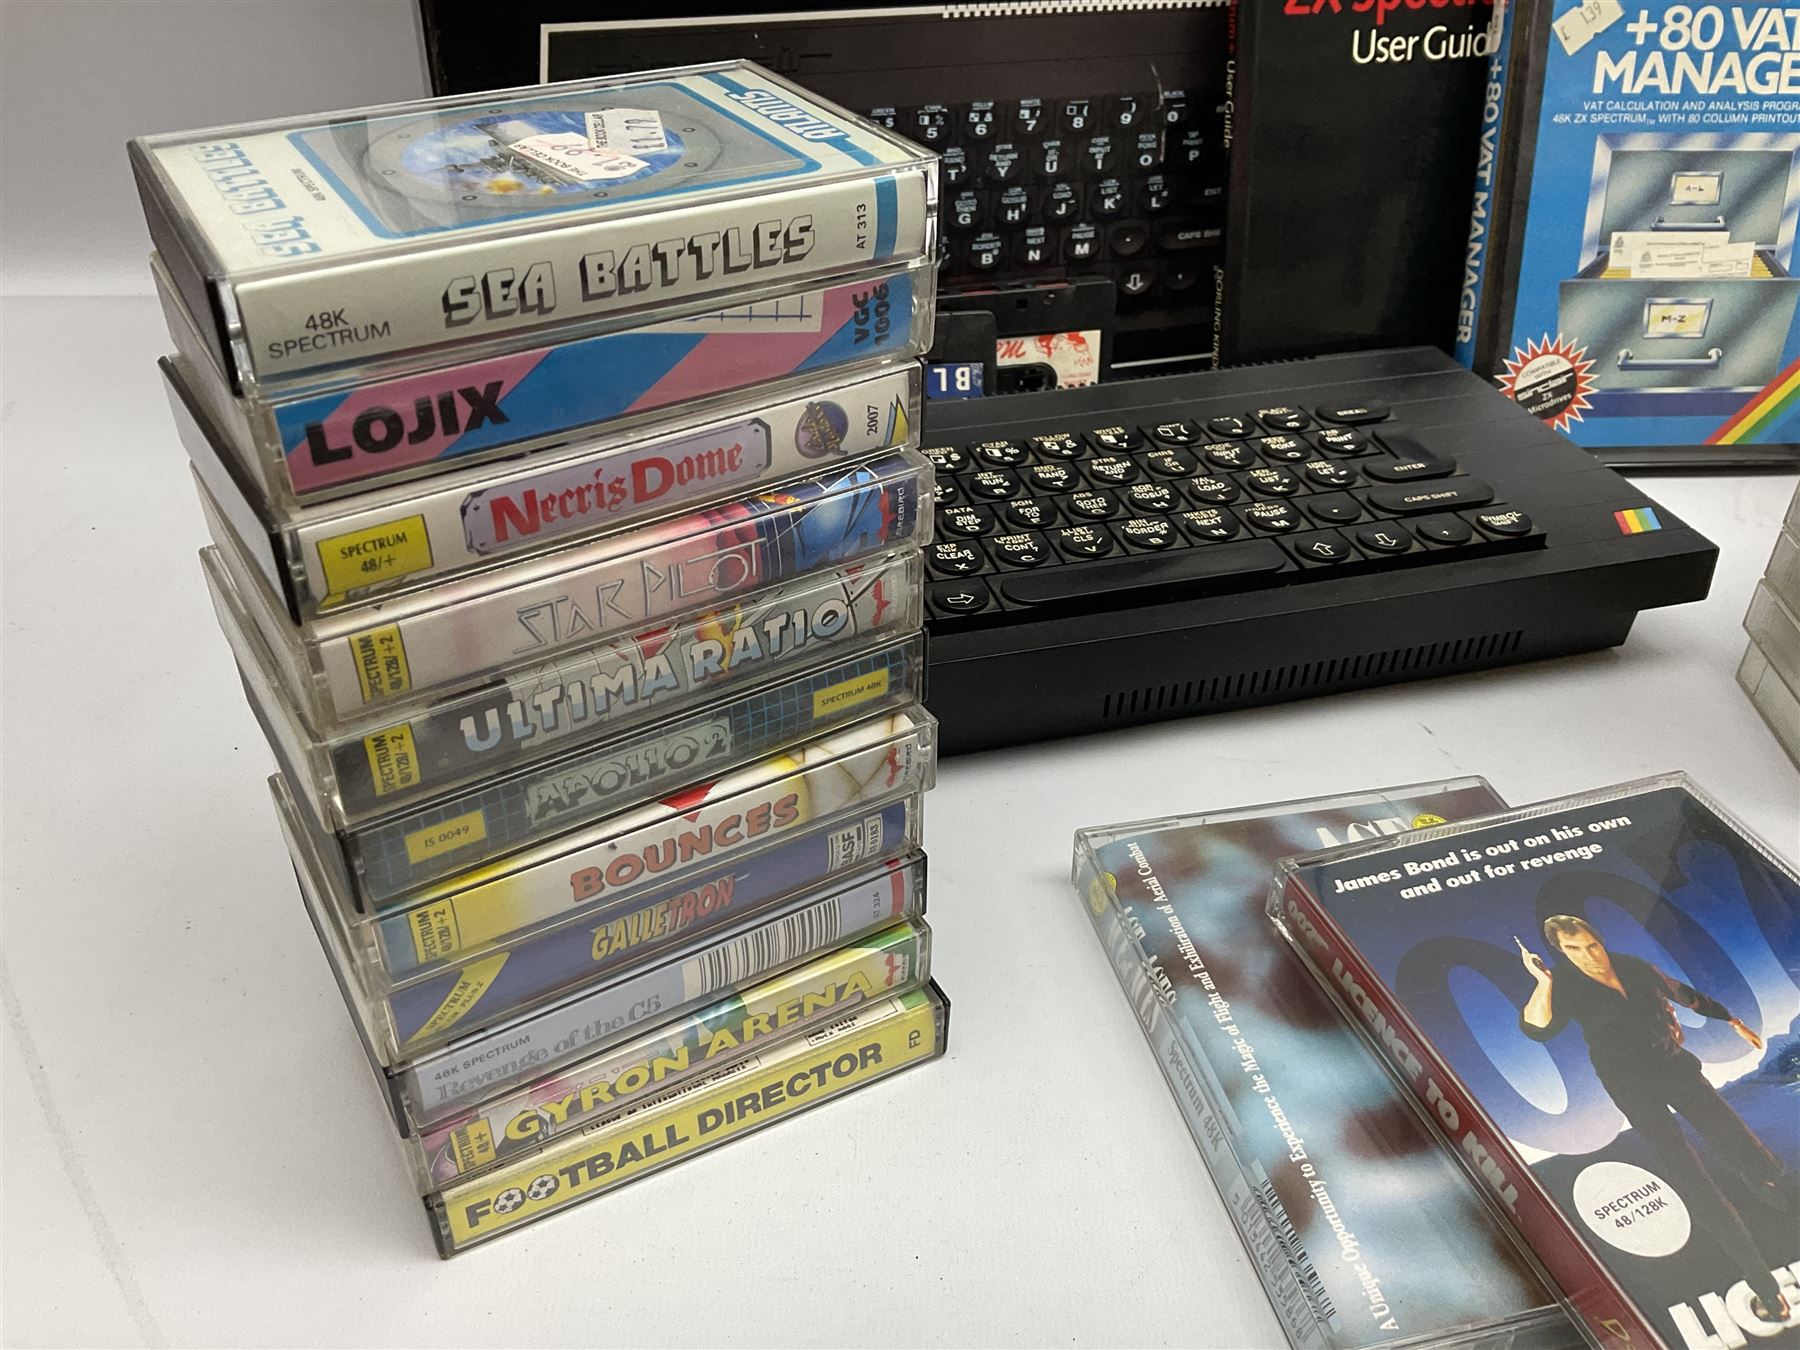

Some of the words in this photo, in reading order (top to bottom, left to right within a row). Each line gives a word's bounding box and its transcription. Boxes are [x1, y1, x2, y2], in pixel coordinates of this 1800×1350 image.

[1626, 5, 1724, 51] +80
[1732, 7, 1800, 51] VAT
[1352, 28, 1419, 64] User
[1423, 25, 1491, 60] Guid
[1226, 60, 1236, 98] User
[1484, 59, 1502, 124] +80
[728, 88, 846, 141] ATLANTIS
[1553, 113, 1571, 123] 48K
[1573, 113, 1589, 123] ZX
[1658, 113, 1685, 123] WITH
[1687, 113, 1701, 123] 80
[1703, 113, 1748, 123] COLUMN
[1583, 101, 1603, 111] VAT
[1606, 101, 1681, 111] CALCULATION
[1682, 101, 1706, 111] AND
[1708, 100, 1760, 111] ANALYSIS
[926, 127, 938, 139] 5
[975, 124, 987, 135] 6
[1026, 120, 1037, 131] 7
[1223, 101, 1235, 149] Guide
[1477, 128, 1497, 185] VAT
[856, 203, 867, 231] 313
[856, 232, 867, 250] AT
[442, 260, 557, 328] SEA
[579, 214, 816, 302] BATTLES
[1456, 192, 1489, 344] MANAGER
[873, 282, 891, 348] 1006
[1213, 268, 1224, 331] DORLING
[305, 308, 349, 331] 48K
[852, 291, 871, 347] VGC
[1662, 314, 1686, 323] M-Z
[268, 321, 391, 359] SPECTRUM
[1212, 335, 1222, 369] KIND
[1517, 372, 1574, 402] sinclair
[1528, 392, 1572, 414] Microdrives
[1542, 391, 1553, 401] ZX
[305, 379, 511, 467] LOJIX
[867, 405, 879, 436] 2007
[1270, 441, 1297, 450] POKE
[1092, 461, 1131, 471] RETURN
[981, 478, 1003, 487] RUN
[1197, 482, 1225, 492] LOAD
[1404, 493, 1431, 504] CAPS
[1432, 490, 1459, 501] SHIFT
[944, 507, 974, 515] DATA
[1195, 517, 1222, 526] NEXT
[1253, 507, 1288, 517] PAUSE
[1481, 511, 1523, 523] SYMBOL
[1073, 535, 1094, 543] CLS
[1125, 522, 1169, 534] BORDER
[340, 532, 408, 560] SPECTRUM
[936, 549, 971, 560] CLEAR
[361, 554, 397, 575] 48/+
[513, 579, 632, 654] STAR
[641, 537, 769, 617] PILOT
[359, 634, 381, 698] SPECTRUM
[460, 656, 681, 751] ULTIMA
[688, 599, 850, 684] RATIO
[821, 686, 865, 708] SPECTRUM
[864, 680, 883, 694] 48K
[372, 734, 395, 795] SPECTRUM
[437, 825, 471, 845] 0049
[571, 793, 801, 902] BOUNCES
[840, 831, 855, 866] BASF
[869, 823, 879, 845] 0183
[1126, 842, 1153, 876] Combat
[1334, 868, 1401, 895] James
[1406, 851, 1461, 877] Bond
[1461, 848, 1483, 866] is
[1485, 840, 1521, 857] out
[1523, 833, 1550, 849] on
[1553, 823, 1584, 843] his
[1588, 814, 1632, 834] own
[1399, 882, 1442, 900] and
[1446, 871, 1482, 890] out
[1484, 860, 1516, 881] for
[1520, 841, 1603, 873] revenge
[1142, 876, 1169, 902] Aerial
[592, 874, 737, 961] GALLETRON
[1156, 905, 1175, 915] of
[417, 911, 436, 960] SPECTRUM
[1193, 971, 1216, 991] and
[1206, 995, 1233, 1026] Flight
[908, 1030, 921, 1049] FD
[1225, 1022, 1241, 1037] of
[435, 1063, 459, 1081] 48K
[463, 1034, 531, 1070] SPECTRUM
[436, 1046, 549, 1101] Revenge
[554, 1030, 584, 1056] of
[584, 1015, 625, 1042] the
[628, 994, 663, 1022] C5
[505, 1046, 689, 1140] GYRON
[705, 971, 873, 1059] ARENA
[1233, 1036, 1260, 1073] Magic
[1167, 1040, 1205, 1116] Spectrum
[1203, 1115, 1225, 1153] 48K
[1252, 1073, 1272, 1095] the
[1332, 957, 1423, 1082] LICENCE
[1426, 1077, 1460, 1132] TO
[1462, 1131, 1521, 1223] KILL
[465, 1124, 689, 1229] FOOTBALL
[697, 1042, 882, 1135] DIRECTOR
[1264, 1095, 1309, 1164] Experience
[1300, 1163, 1317, 1178] to
[1594, 1181, 1662, 1221] SPECTRUM
[1615, 1196, 1669, 1229] 48/128K
[1308, 1179, 1361, 1263] Opportunity
[1353, 1263, 1391, 1320] Unique
[1668, 1260, 1800, 1350] LICE
[1379, 1317, 1400, 1331] A
